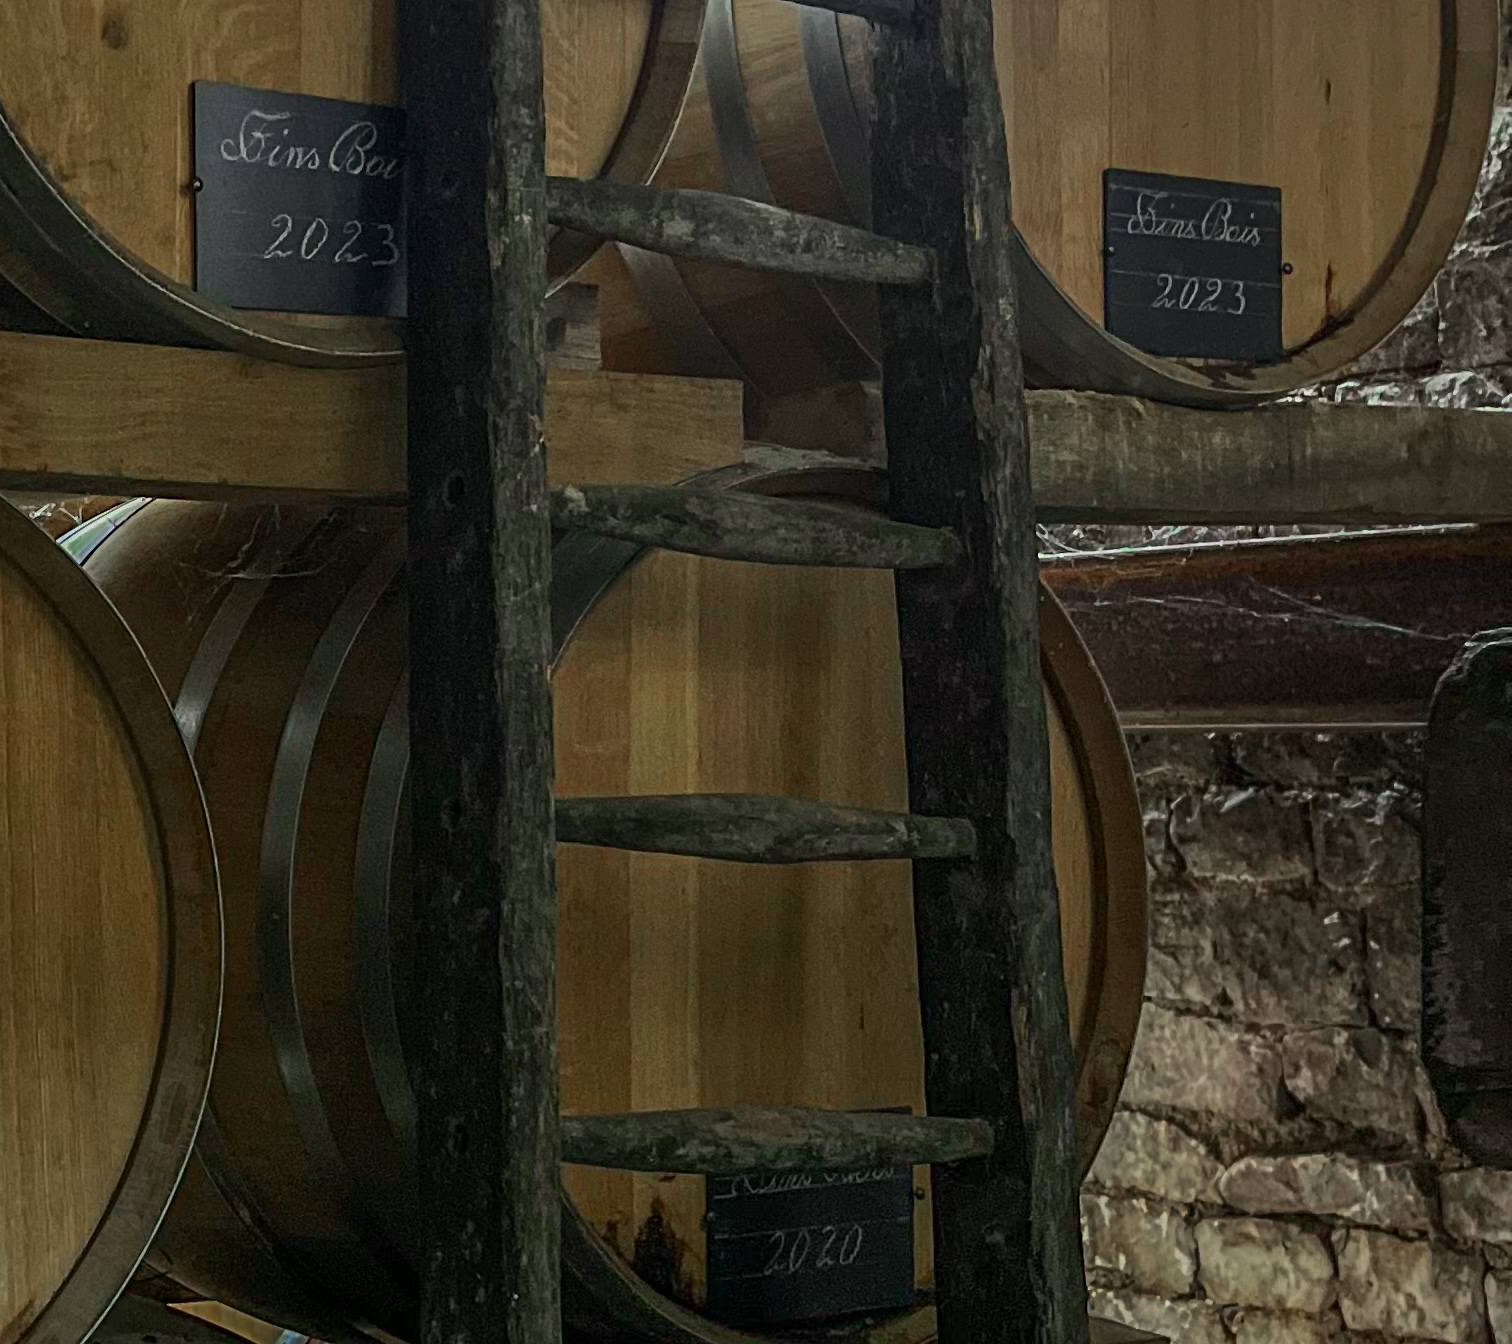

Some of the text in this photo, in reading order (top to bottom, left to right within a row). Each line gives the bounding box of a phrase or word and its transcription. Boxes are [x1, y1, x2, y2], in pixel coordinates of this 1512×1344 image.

[220, 108, 404, 180] Fins Boi
[263, 213, 400, 268] 2023
[1200, 197, 1262, 247] Bois
[1152, 272, 1247, 316] 2023
[763, 1223, 863, 1276] 2020
